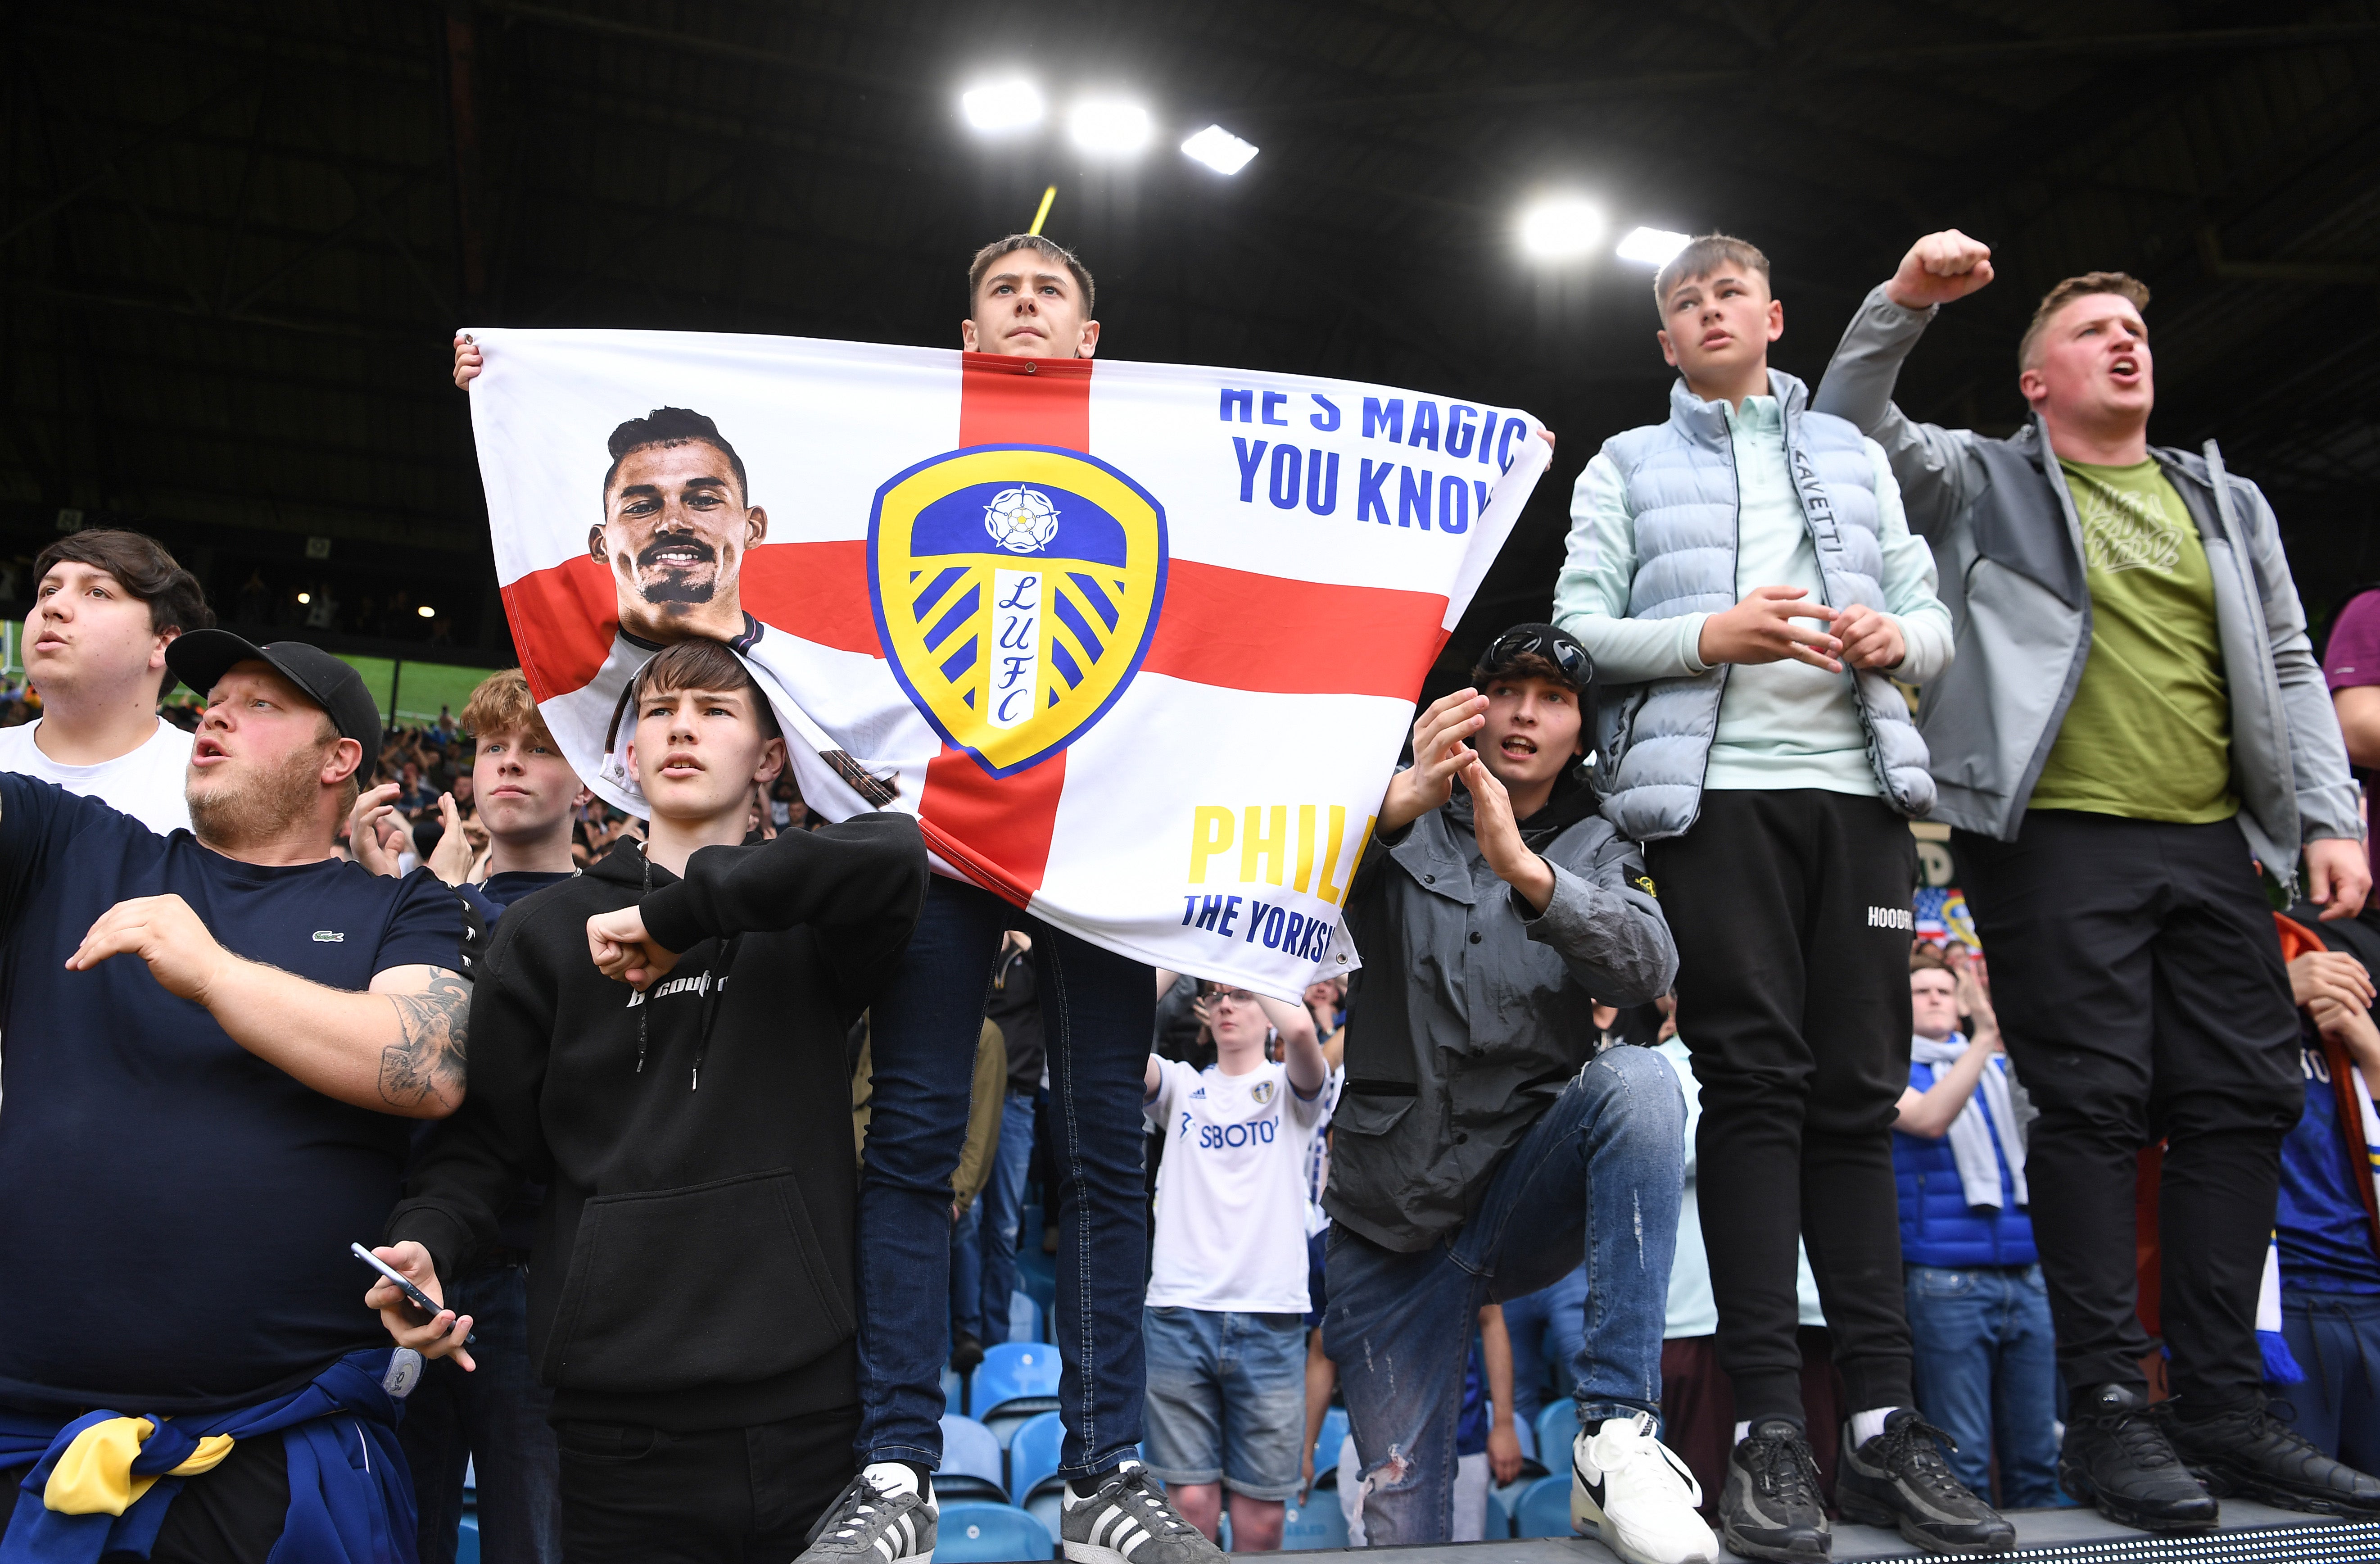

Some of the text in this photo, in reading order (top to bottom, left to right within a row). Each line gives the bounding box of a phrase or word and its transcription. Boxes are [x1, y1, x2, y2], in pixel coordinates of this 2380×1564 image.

[1232, 436, 1339, 516] YOU
[997, 576, 1036, 722] LUFC
[1181, 894, 1243, 938] THE
